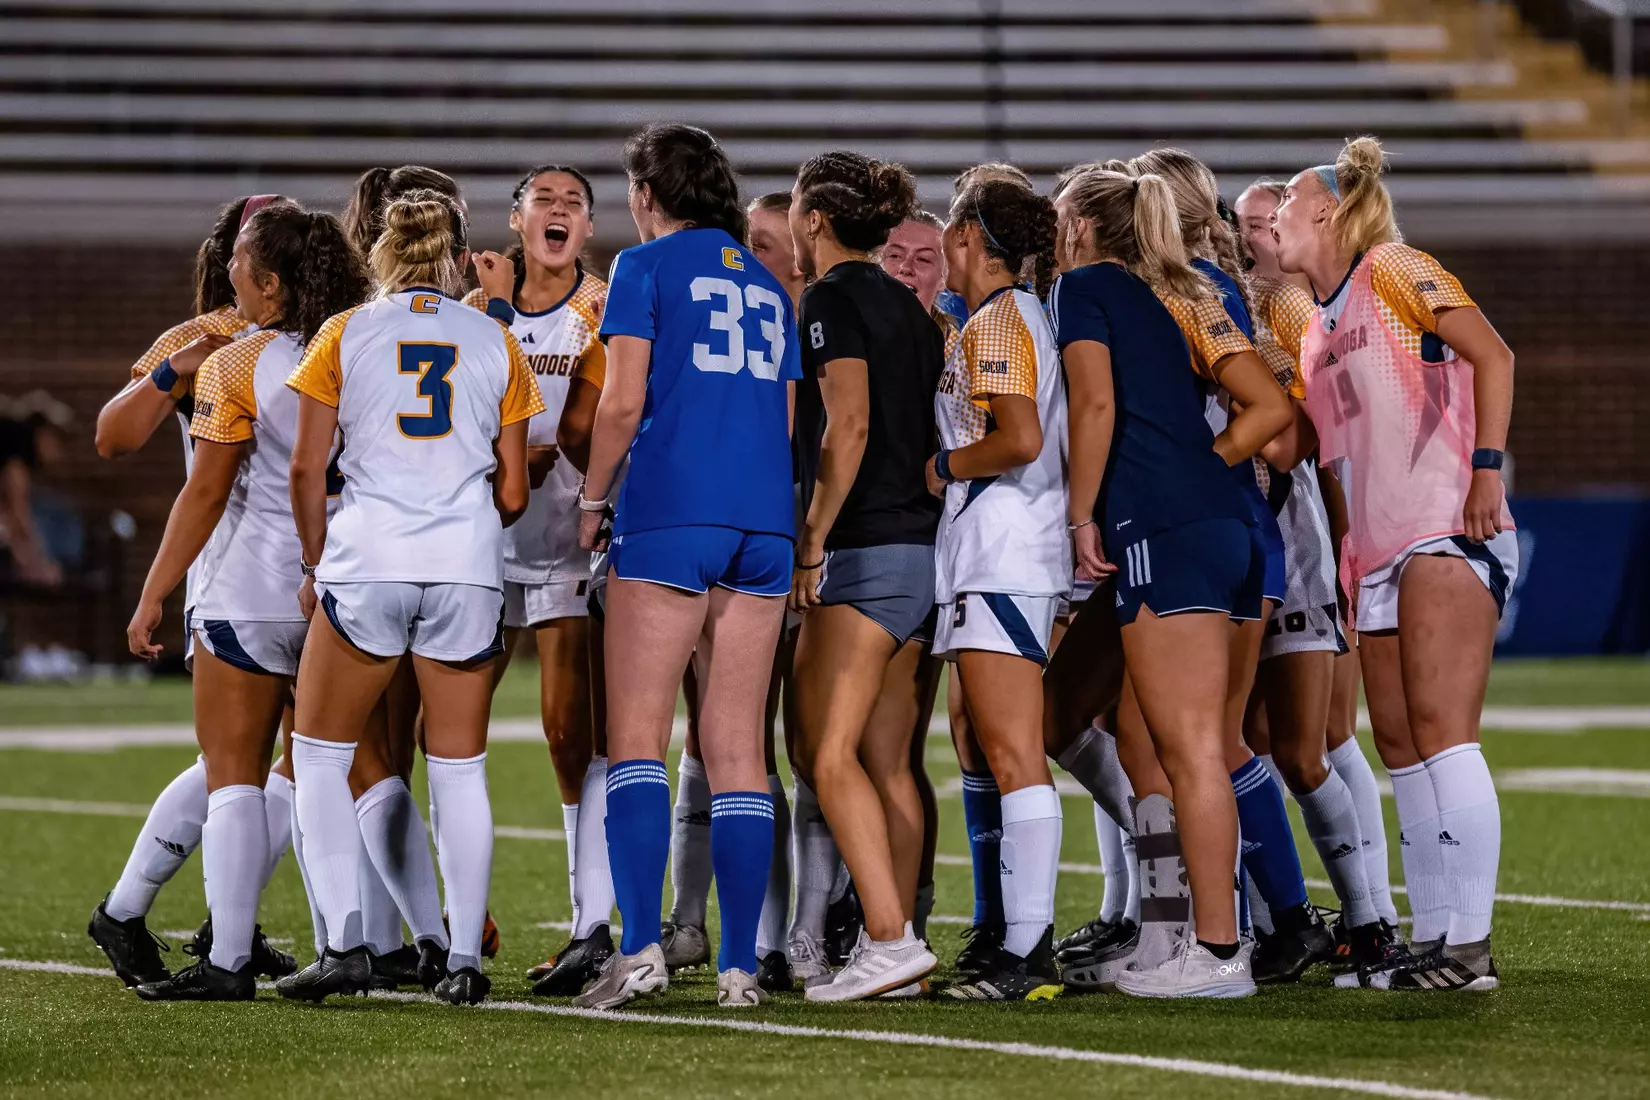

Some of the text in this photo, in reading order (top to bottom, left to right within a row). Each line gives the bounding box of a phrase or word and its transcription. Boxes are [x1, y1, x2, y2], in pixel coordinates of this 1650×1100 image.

[721, 246, 744, 272] C
[410, 294, 442, 314] C
[689, 276, 786, 382] 33
[809, 321, 826, 350] 8
[979, 360, 1008, 375] SOCON
[396, 341, 459, 440] 3
[1209, 961, 1246, 978] HOKA
